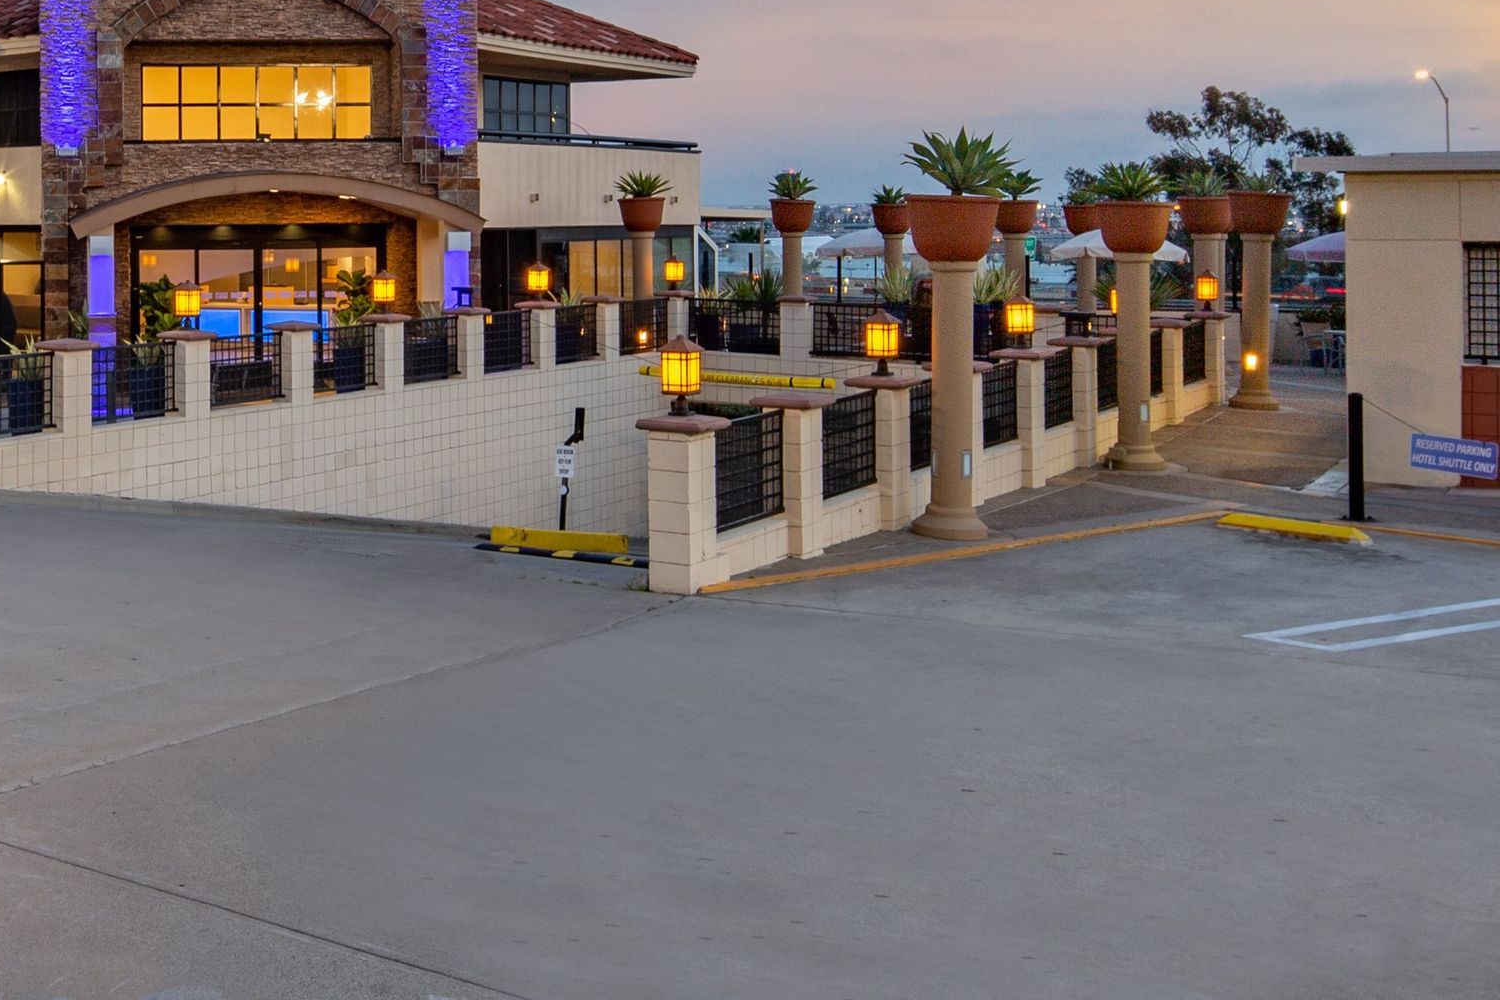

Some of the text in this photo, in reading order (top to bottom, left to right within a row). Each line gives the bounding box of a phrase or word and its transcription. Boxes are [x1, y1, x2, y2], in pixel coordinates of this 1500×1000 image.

[1415, 439, 1493, 458] RESERVED PARKING
[1412, 453, 1496, 474] HOTEL SHUTTLE ONLY
